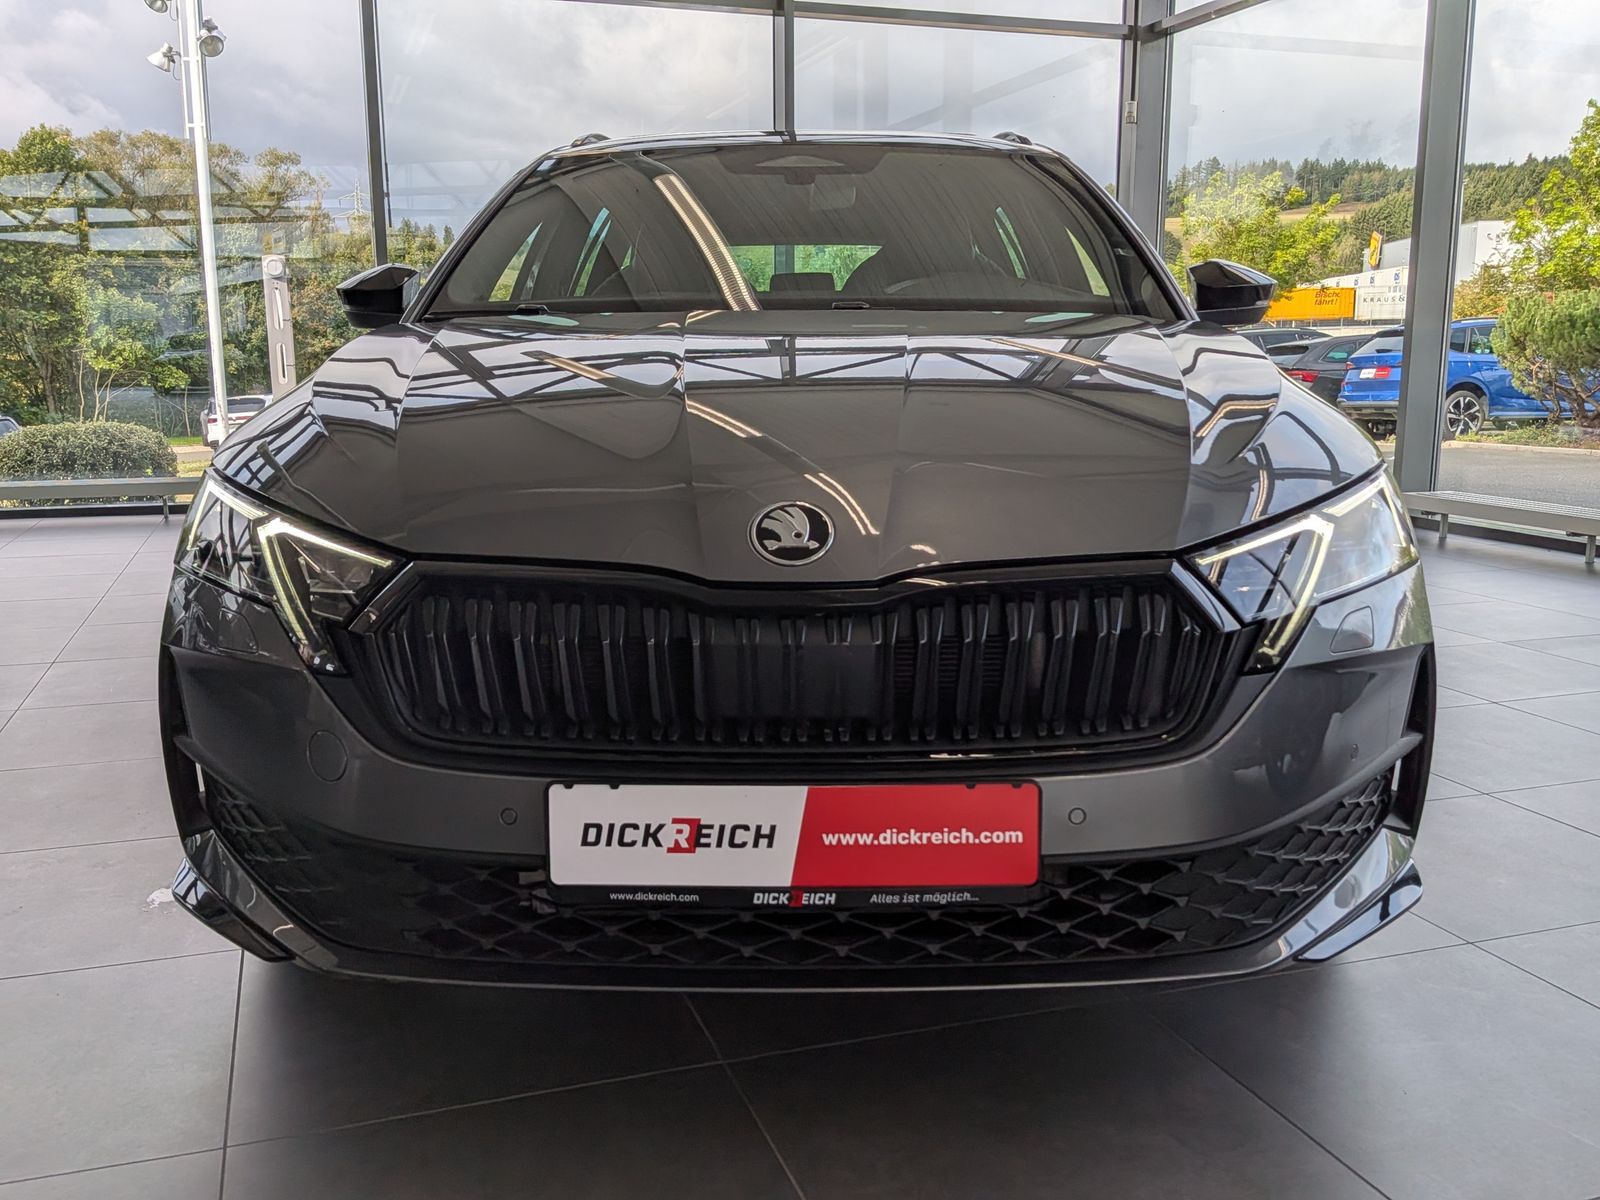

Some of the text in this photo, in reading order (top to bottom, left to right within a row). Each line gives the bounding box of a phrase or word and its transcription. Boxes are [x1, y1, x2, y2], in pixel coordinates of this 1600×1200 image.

[580, 818, 777, 853] DICKREICH
[822, 828, 1024, 845] www.dickreich.com
[609, 892, 700, 902] www.dickreich.com
[752, 891, 837, 906] DICKEICH
[869, 893, 900, 904] Alles
[902, 892, 920, 903] ist
